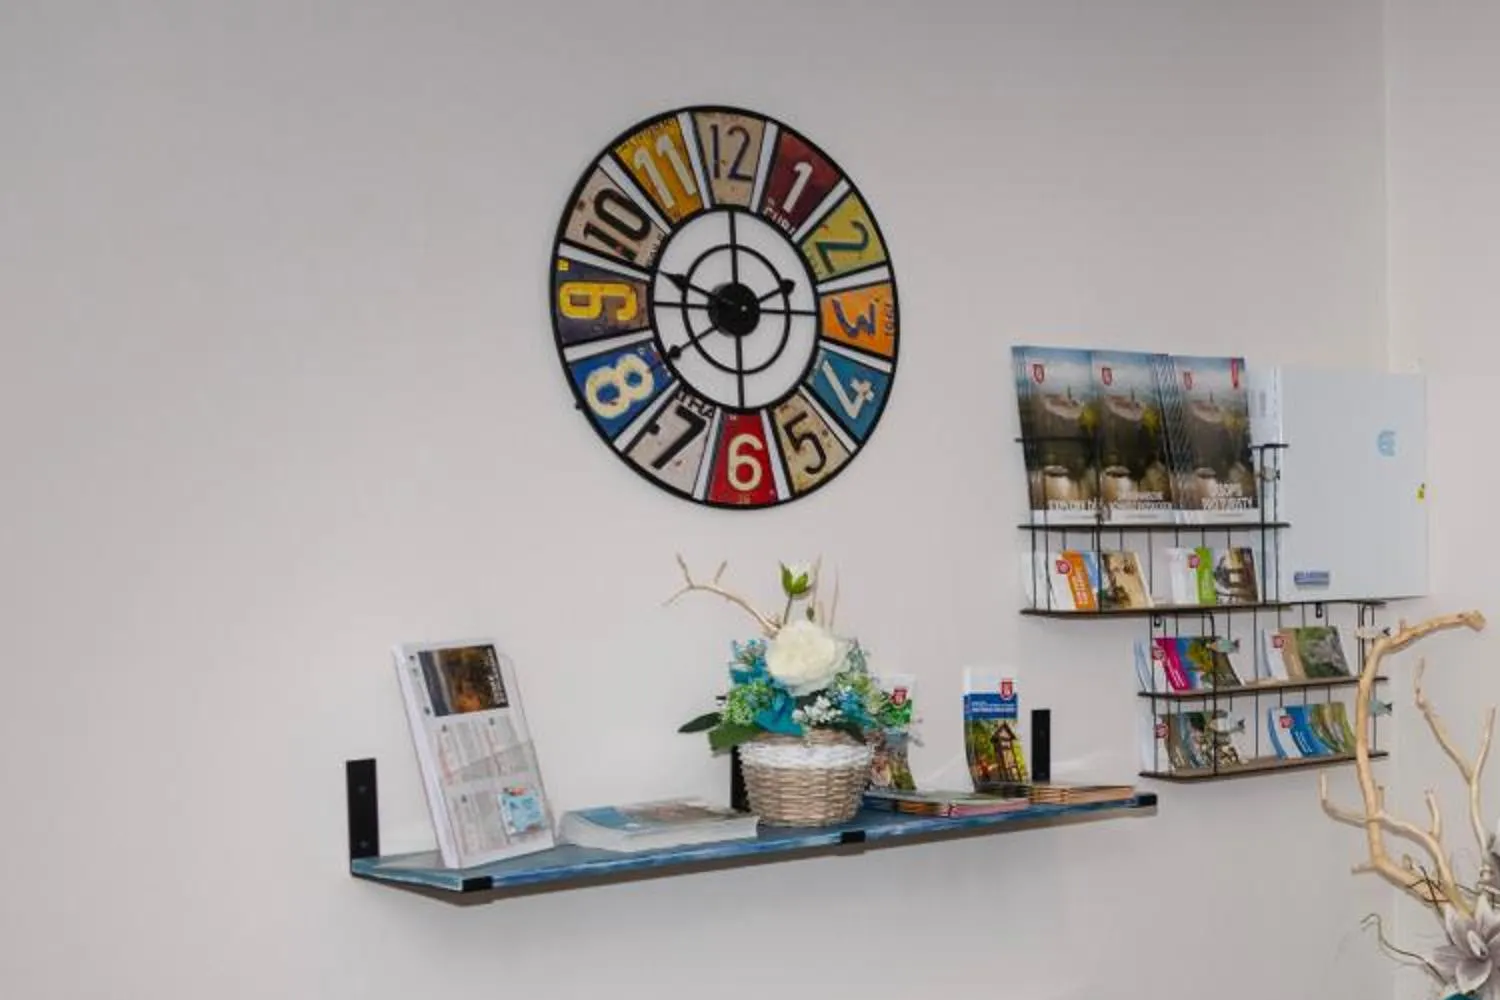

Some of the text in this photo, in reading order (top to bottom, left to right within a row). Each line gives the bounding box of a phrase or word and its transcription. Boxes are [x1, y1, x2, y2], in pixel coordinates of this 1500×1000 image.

[633, 132, 698, 210] 11
[710, 123, 752, 182] 12
[783, 161, 813, 214] 1
[583, 186, 652, 262] 10
[815, 220, 869, 274] 2
[558, 279, 638, 322] 9
[831, 297, 876, 338] 3
[584, 352, 655, 420] 8
[821, 360, 875, 419] 4
[651, 404, 706, 470] 7
[727, 433, 763, 492] 6
[783, 411, 827, 474] 5
